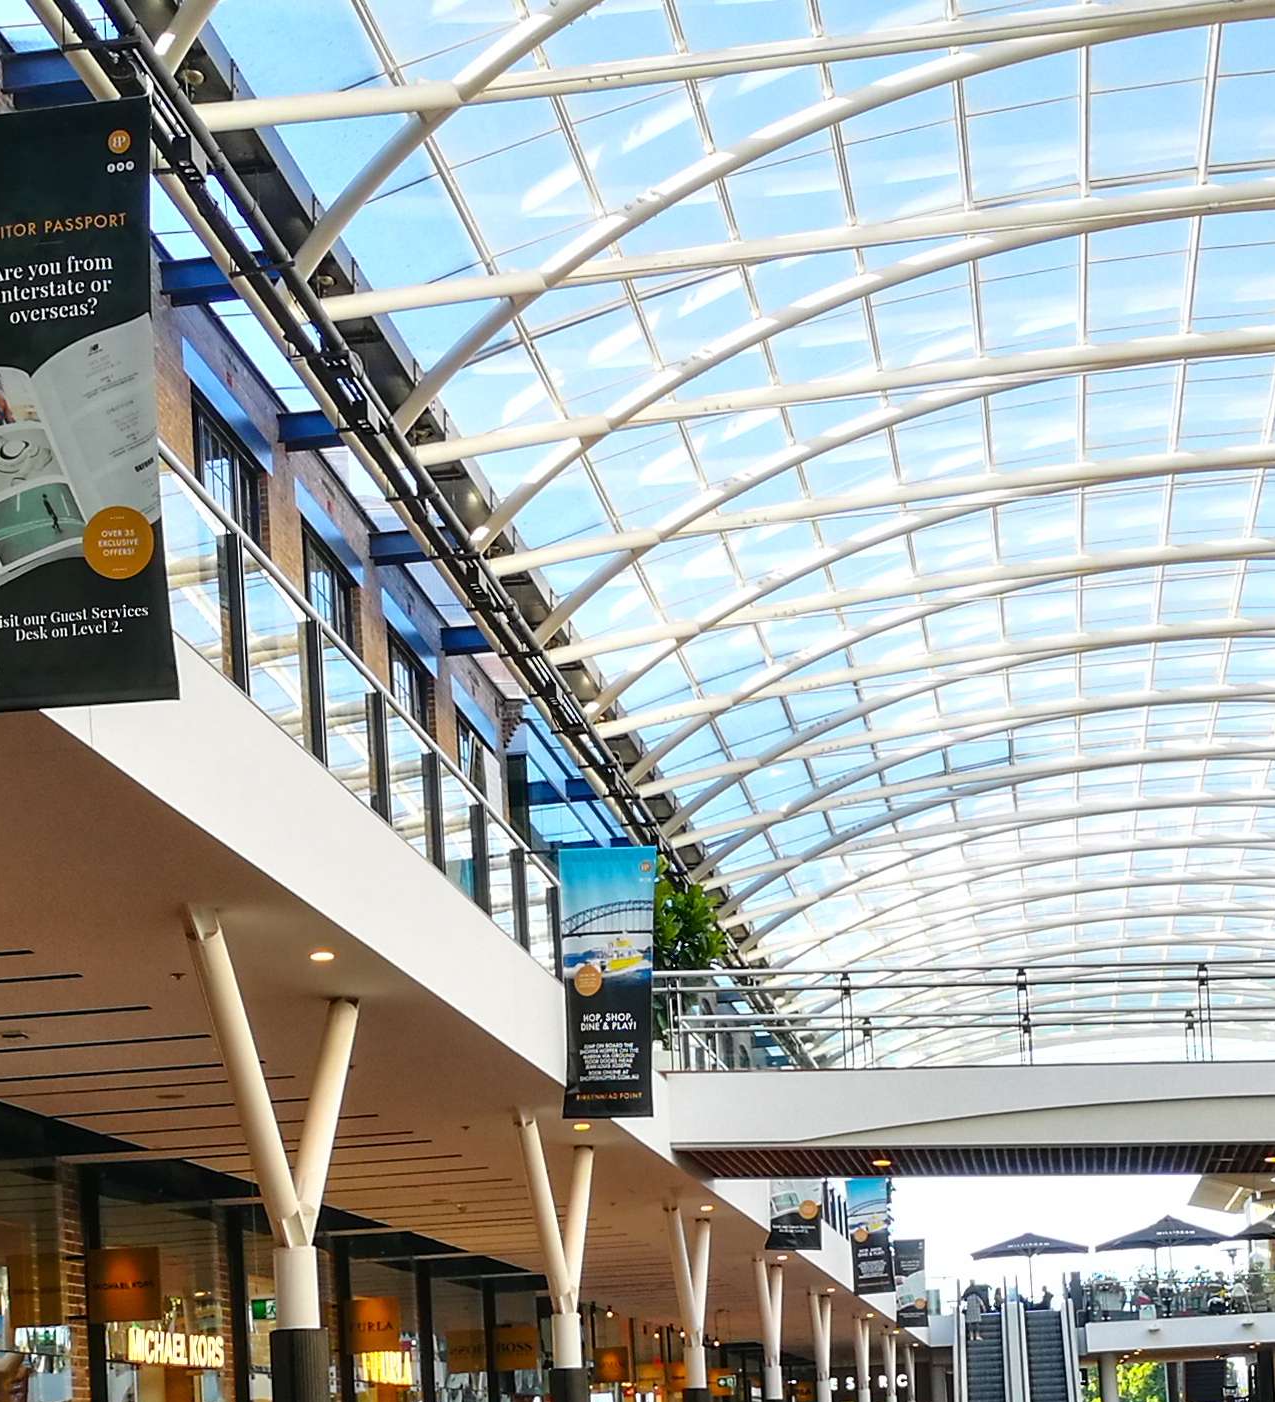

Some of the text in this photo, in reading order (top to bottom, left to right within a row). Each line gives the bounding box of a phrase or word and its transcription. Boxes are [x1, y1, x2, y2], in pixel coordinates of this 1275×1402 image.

[44, 212, 126, 233] PASSPORT
[28, 260, 62, 281] you
[67, 255, 113, 273] from
[90, 278, 112, 292] or
[10, 297, 98, 324] overseas?
[24, 614, 47, 627] our
[50, 608, 88, 624] Guest
[91, 604, 149, 620] Services
[15, 620, 123, 642] Desk on Level 2.
[580, 1022, 636, 1031] DINE & PLAY!
[583, 1012, 633, 1023] HOP, SHOP,
[128, 1327, 224, 1368] MICHAEL KORS
